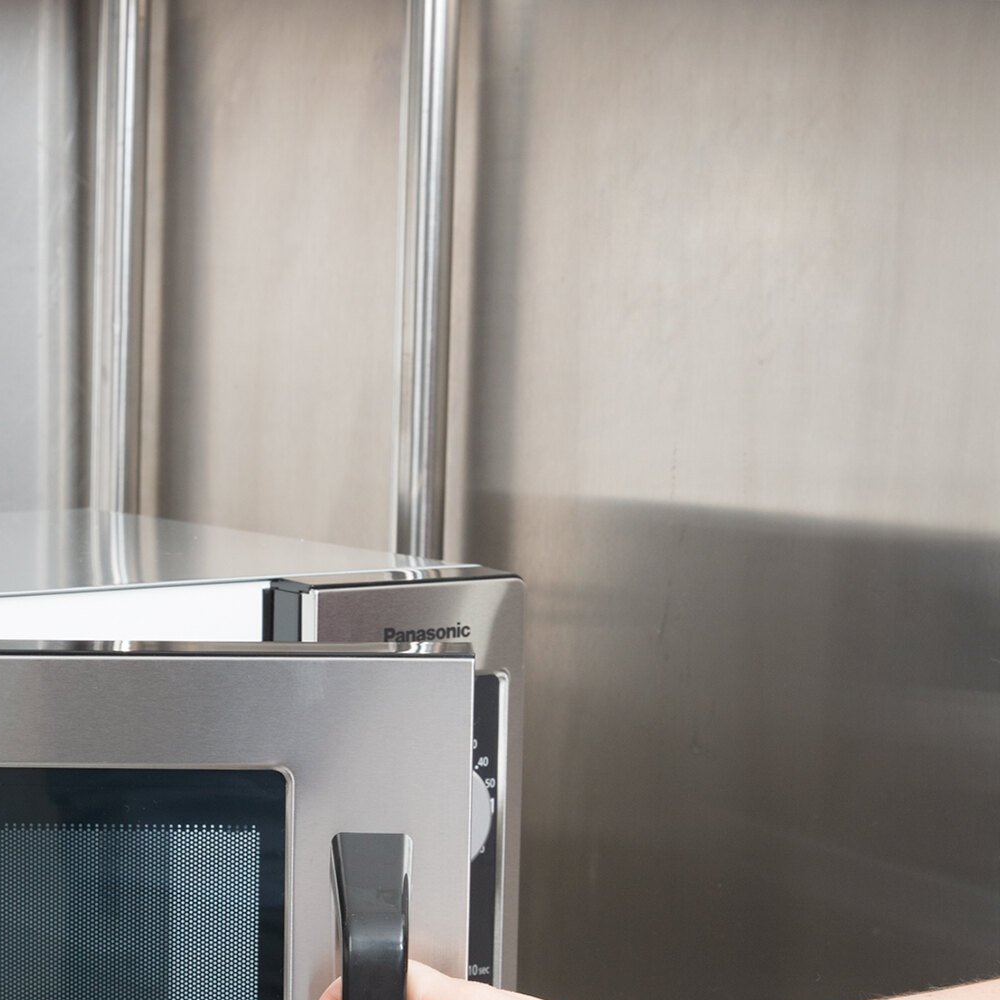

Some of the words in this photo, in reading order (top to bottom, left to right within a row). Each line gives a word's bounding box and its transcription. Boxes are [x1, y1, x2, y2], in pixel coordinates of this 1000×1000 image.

[383, 622, 471, 643] Panasonic
[477, 756, 489, 767] 40
[485, 778, 496, 788] 50
[468, 964, 478, 976] 10
[478, 966, 490, 975] sec
